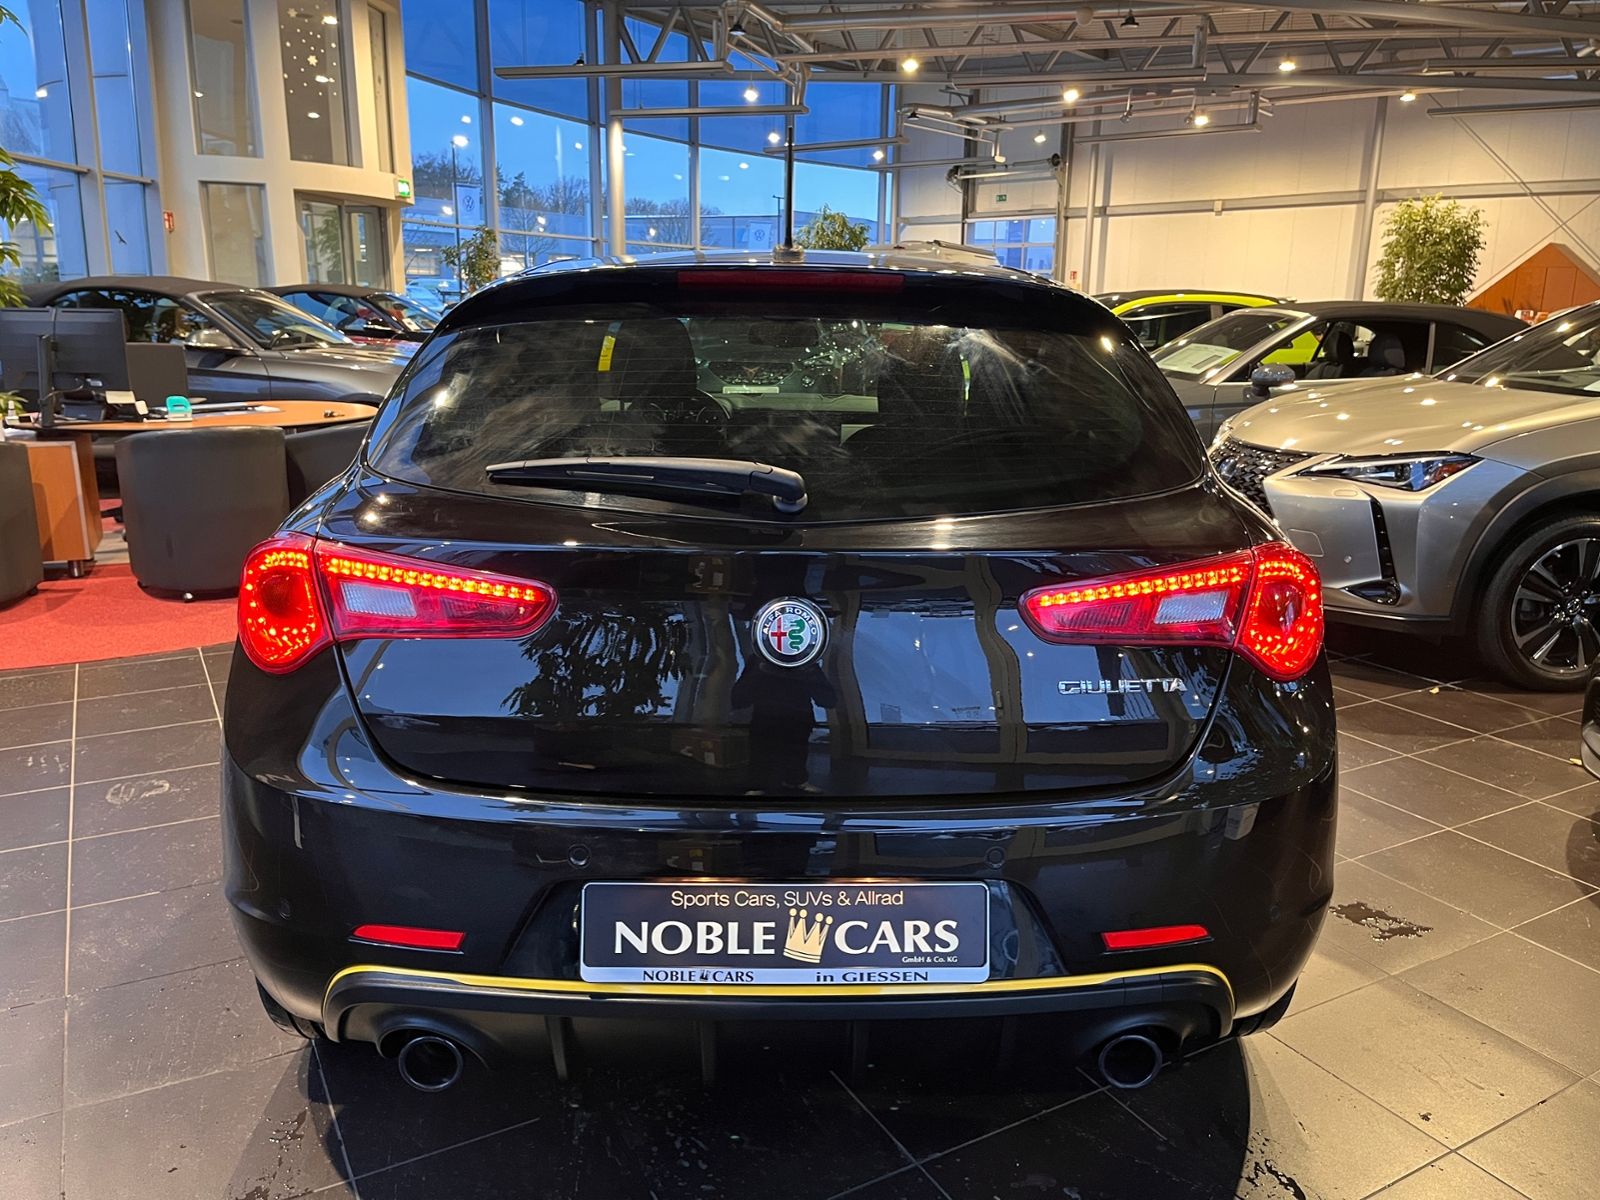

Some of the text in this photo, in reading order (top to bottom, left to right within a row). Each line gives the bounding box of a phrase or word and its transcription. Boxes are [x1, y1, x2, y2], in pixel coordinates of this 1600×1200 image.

[763, 607, 817, 635] ALFA ROMEO
[1058, 678, 1188, 695] GIULIETTA
[671, 890, 904, 909] Sports Cars, SUVs & Allrad
[614, 920, 960, 955] NOBLE CARS
[643, 970, 754, 982] NOBLE CARS
[816, 971, 928, 982] in GIESSEN
